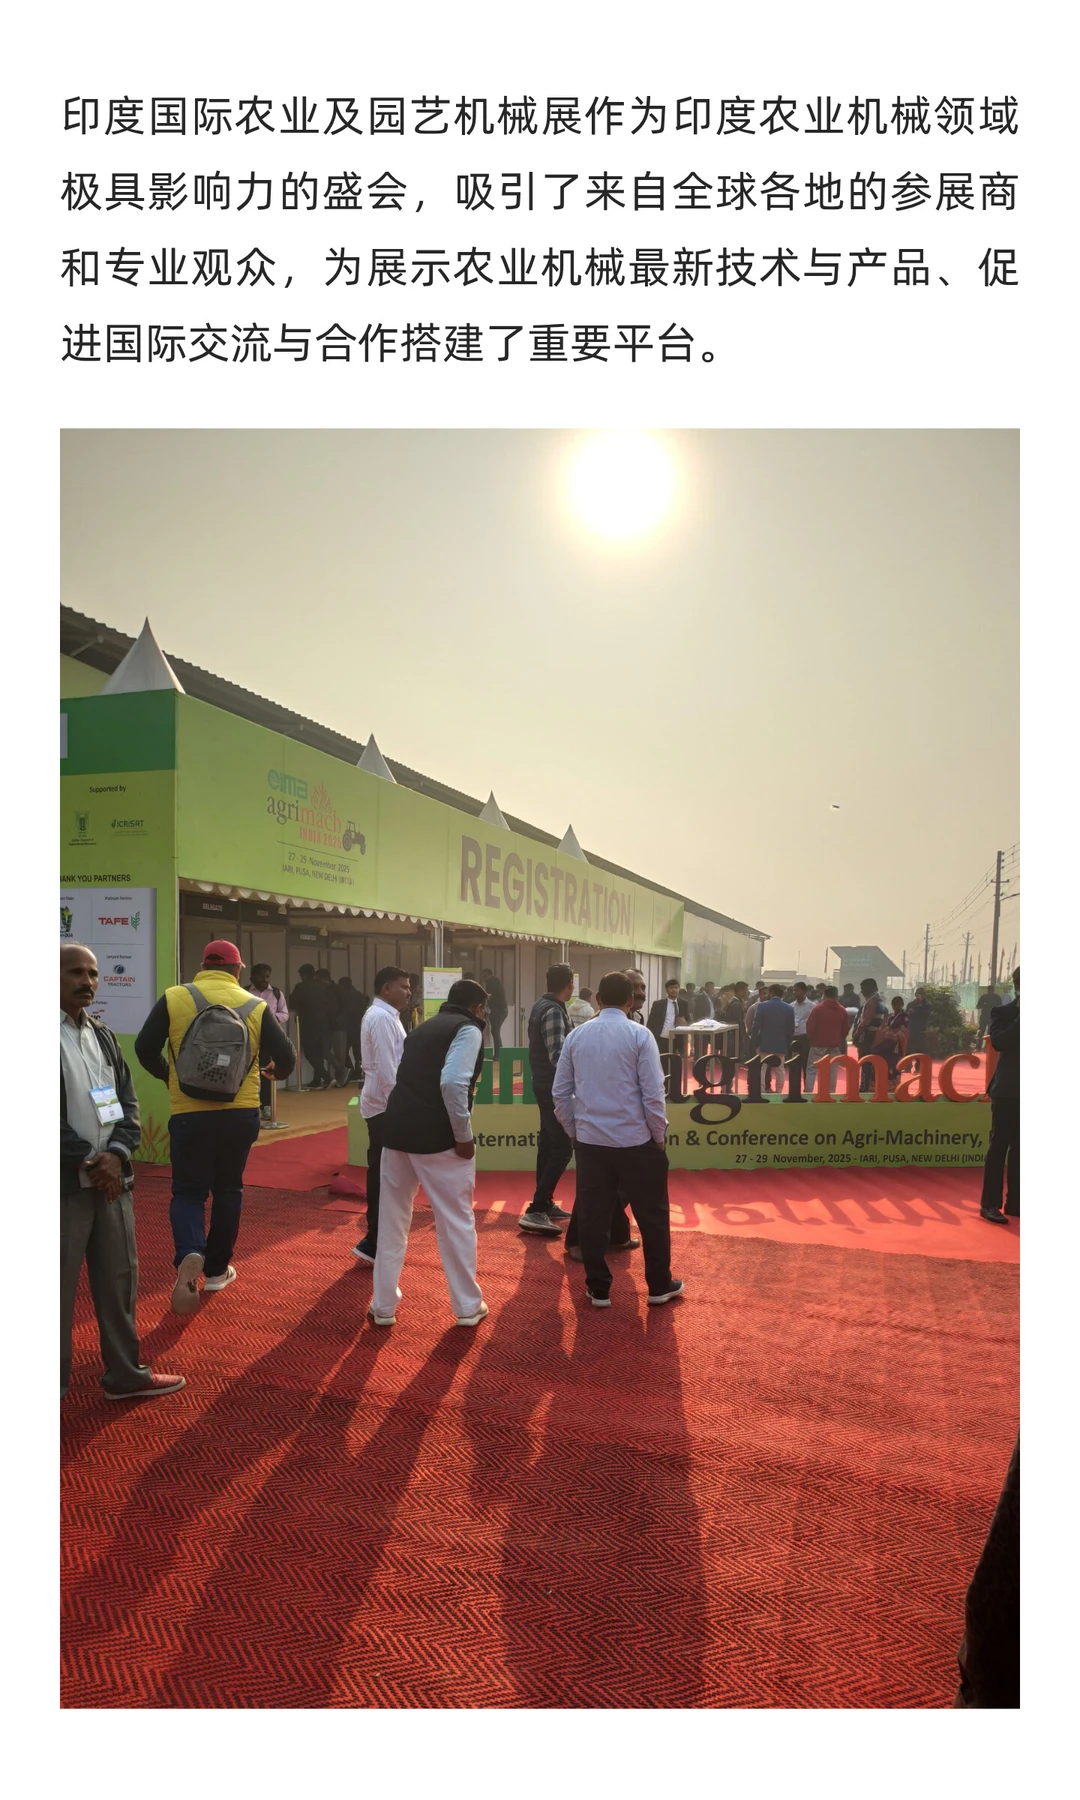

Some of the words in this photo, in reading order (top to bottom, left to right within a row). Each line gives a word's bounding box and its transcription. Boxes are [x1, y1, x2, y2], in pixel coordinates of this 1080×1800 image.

[89, 785, 118, 794] Supported
[119, 785, 127, 793] by
[267, 769, 308, 800] eima
[266, 796, 342, 834] agrimach
[300, 826, 321, 845] INDIA
[323, 832, 343, 849] 2025
[288, 851, 295, 861] 27
[300, 854, 307, 864] 29
[338, 863, 350, 874] 2025
[77, 875, 92, 883] YOU
[93, 874, 131, 883] PARTNERS
[311, 870, 324, 880] NEW
[460, 834, 632, 937] REGISTRATION
[98, 917, 129, 925] TAFE
[660, 1033, 999, 1125] agrimac
[685, 1130, 701, 1147] &
[706, 1130, 809, 1147] Conference
[814, 1133, 836, 1146] on
[842, 1129, 983, 1149] Agri-Machinery,
[735, 1154, 747, 1163] 27
[756, 1154, 768, 1163] 29
[773, 1153, 825, 1165] November,
[828, 1153, 852, 1163] 2025
[860, 1154, 880, 1165] IARI,
[883, 1154, 909, 1165] PUSA,
[912, 1154, 933, 1163] NEW
[935, 1154, 960, 1163] DELHI
